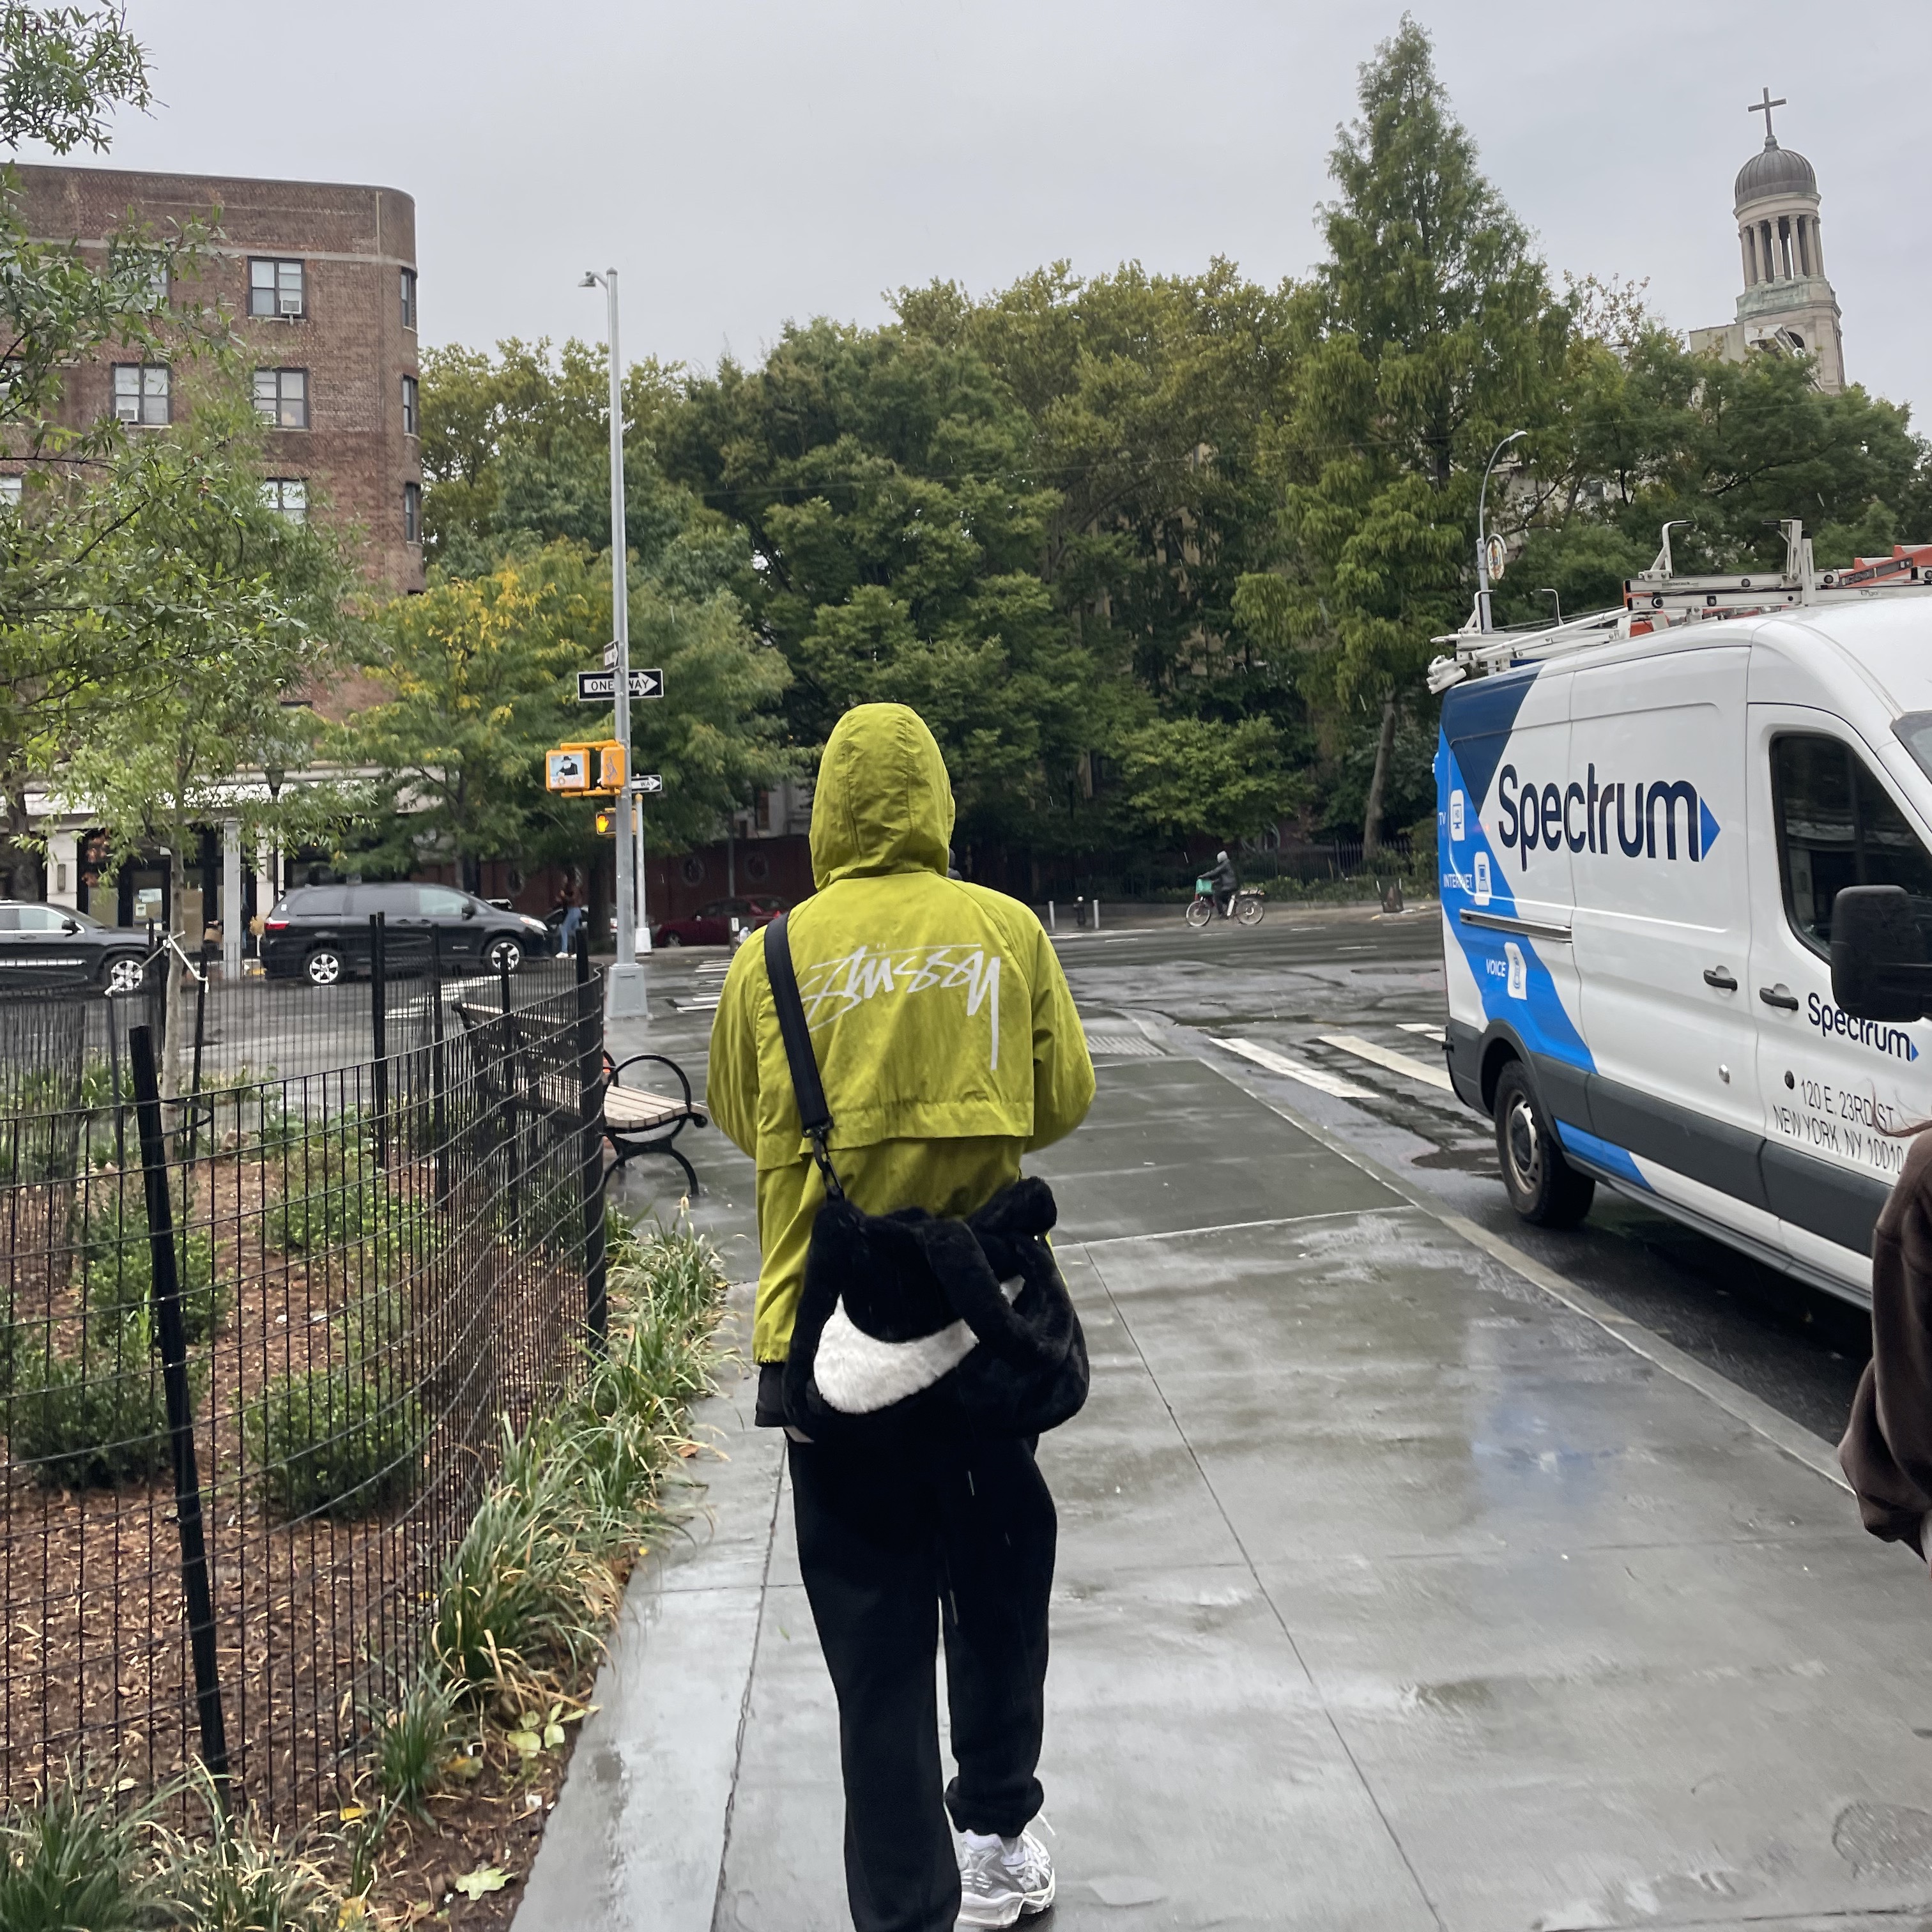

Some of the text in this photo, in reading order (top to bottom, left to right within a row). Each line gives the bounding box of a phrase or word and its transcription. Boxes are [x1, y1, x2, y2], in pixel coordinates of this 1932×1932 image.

[591, 680, 614, 691] ONE
[1439, 811, 1446, 825] TV
[1498, 763, 1699, 872] Spectrum
[1486, 958, 1506, 977] VOICE
[1807, 992, 1912, 1062] Spectrum
[1801, 1078, 1894, 1131] 120 E. 23RD ST
[1773, 1104, 1801, 1138] NEW
[1844, 1128, 1862, 1160] NY
[1867, 1137, 1904, 1175] 10010
